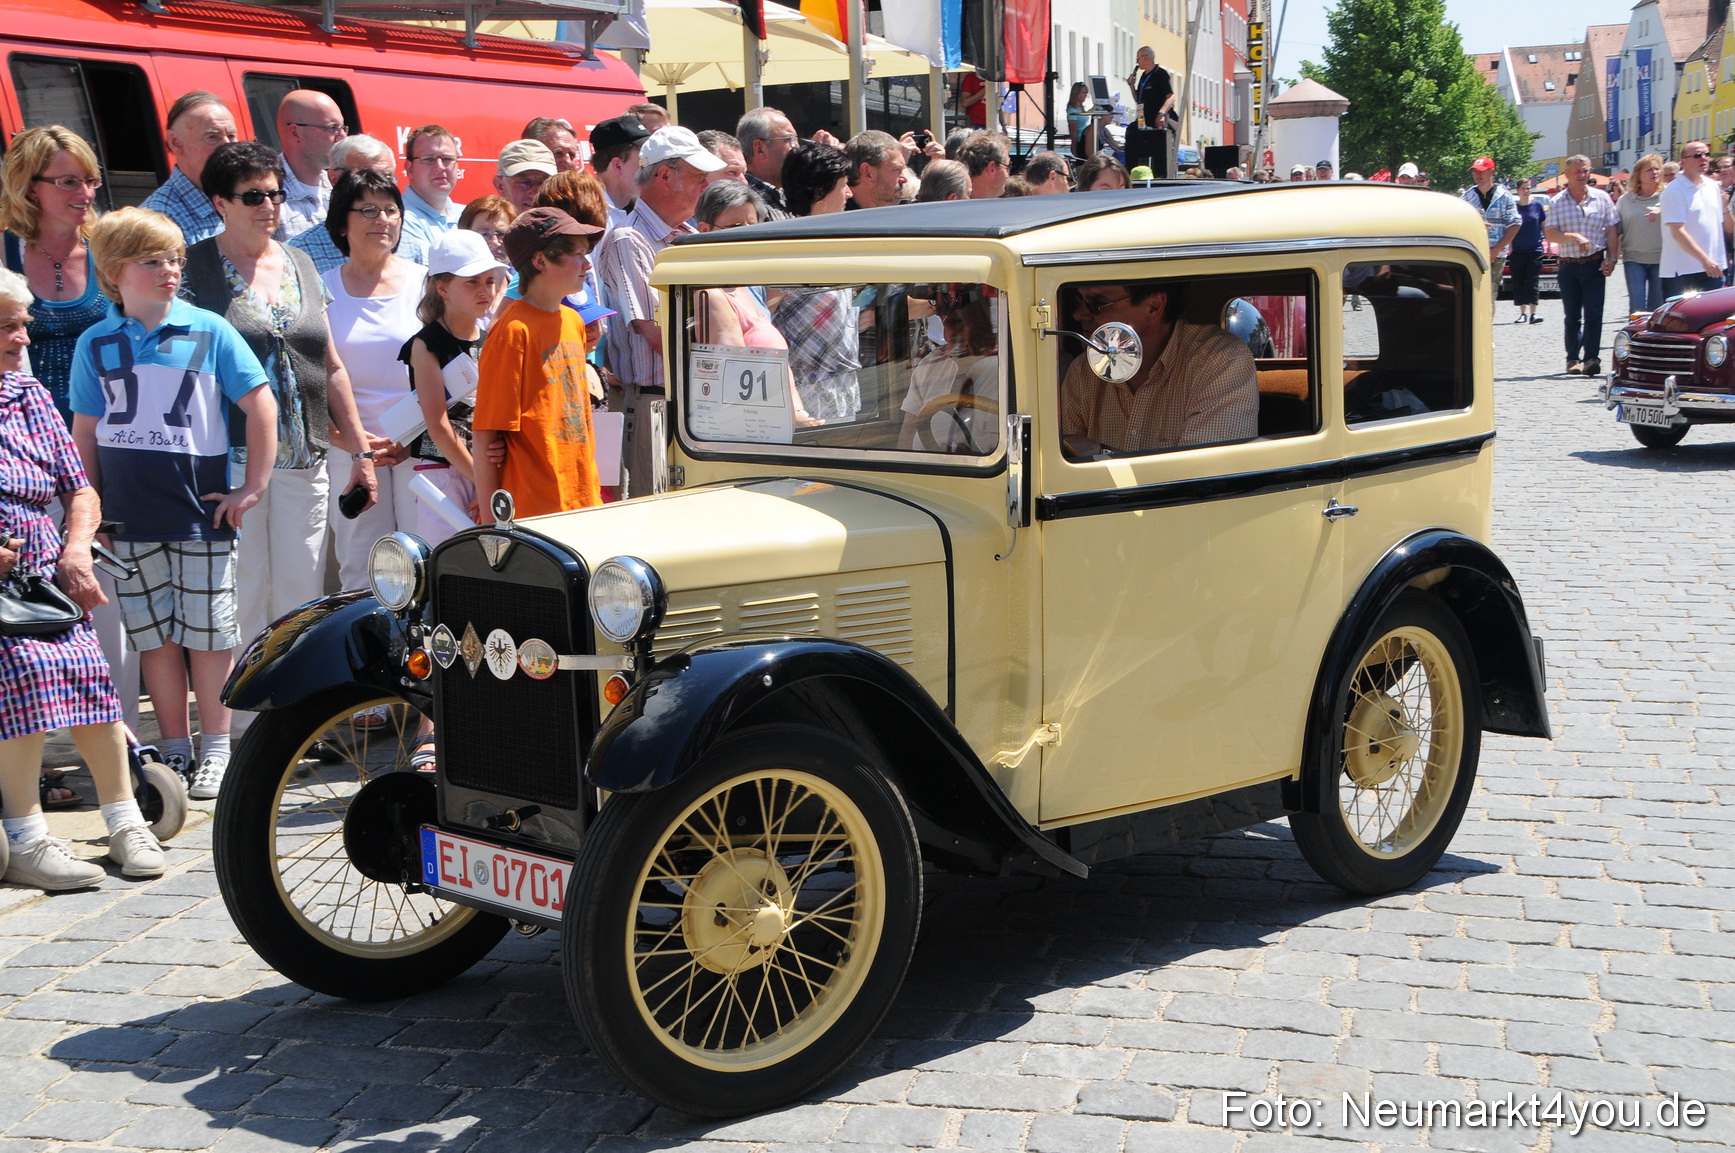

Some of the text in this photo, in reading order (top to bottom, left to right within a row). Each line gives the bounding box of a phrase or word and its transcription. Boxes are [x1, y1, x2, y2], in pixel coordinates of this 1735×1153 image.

[1250, 23, 1268, 125] HOTEL
[90, 323, 212, 428] 87
[738, 369, 767, 401] 91
[1636, 408, 1646, 423] TO
[149, 430, 189, 448] Ball
[428, 863, 434, 874] D
[440, 840, 564, 911] EI 0701
